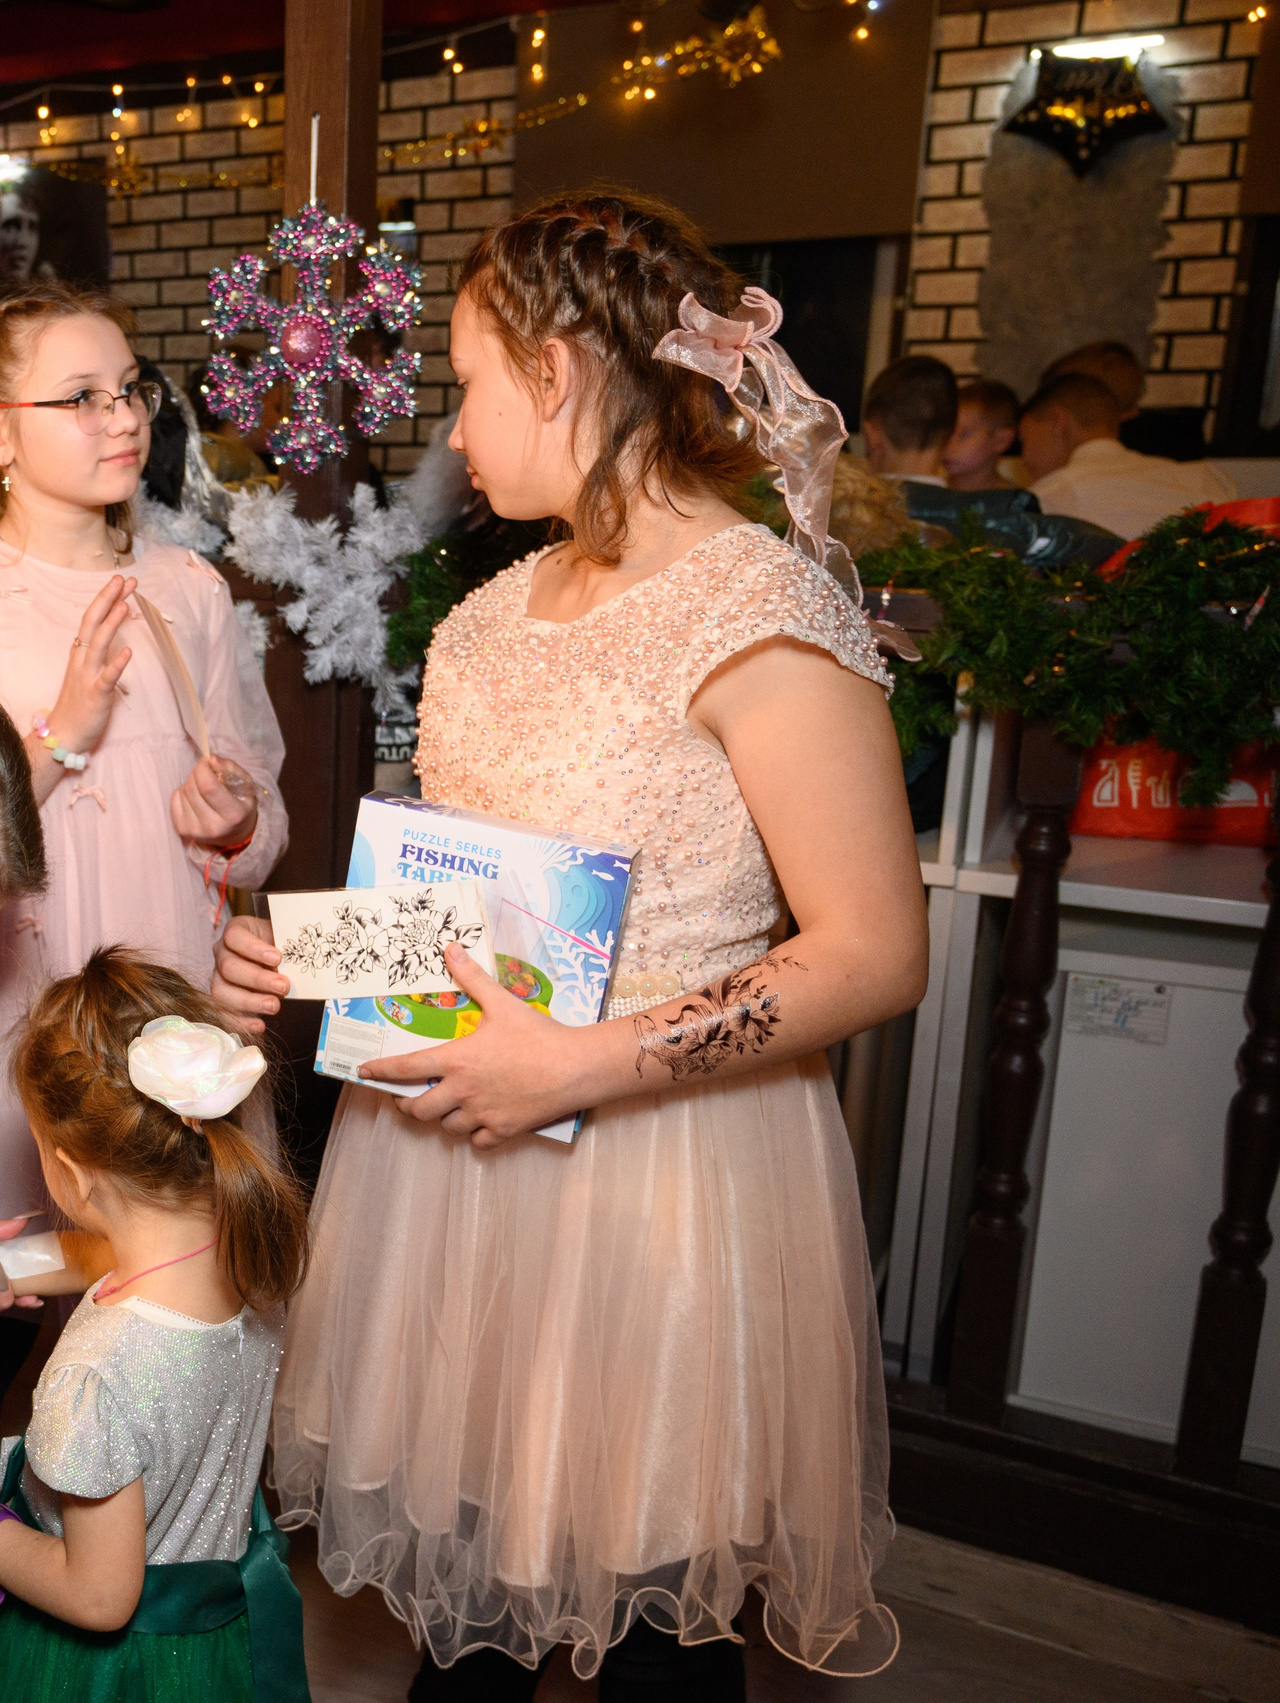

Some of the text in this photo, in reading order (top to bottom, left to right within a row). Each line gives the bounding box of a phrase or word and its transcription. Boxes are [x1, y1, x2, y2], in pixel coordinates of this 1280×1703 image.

[403, 828, 502, 859] PUZZLE SERLES
[397, 862, 473, 883] TAB
[399, 843, 499, 880] FISHING
